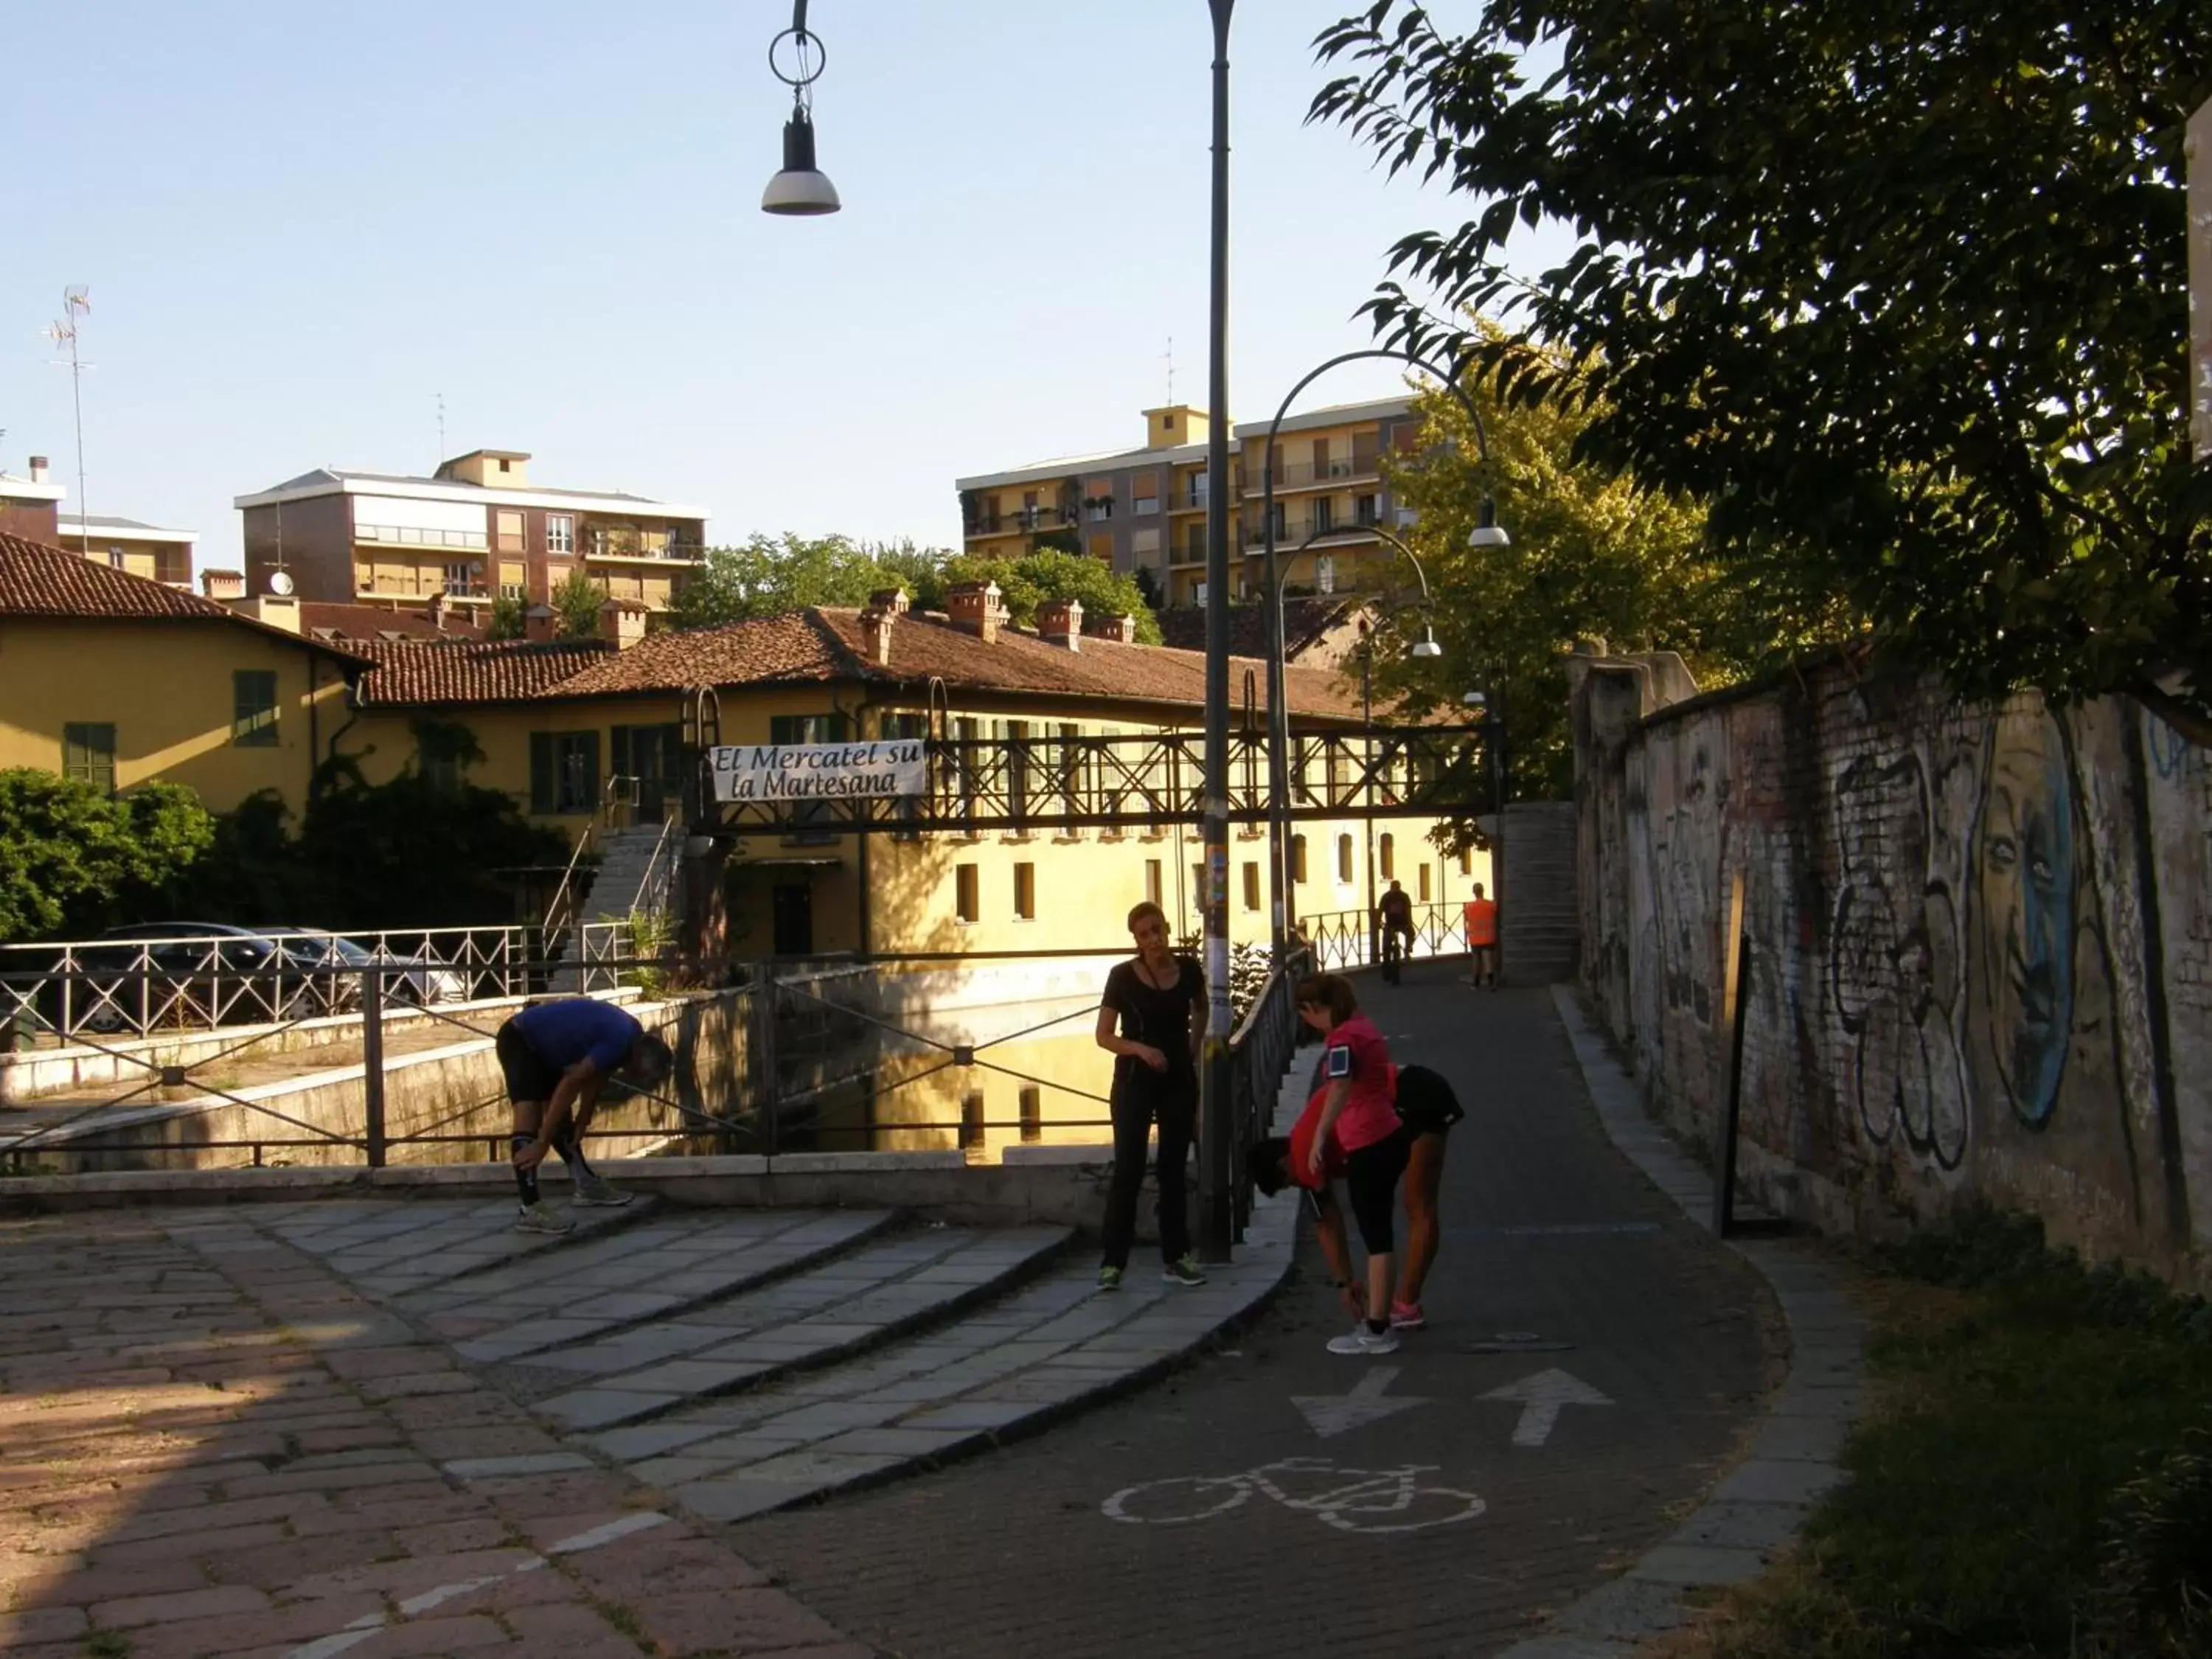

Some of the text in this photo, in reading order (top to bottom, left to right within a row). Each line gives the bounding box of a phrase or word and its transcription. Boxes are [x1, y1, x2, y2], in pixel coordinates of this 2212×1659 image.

[715, 742, 920, 772] El Mercatel su
[731, 771, 898, 799] la Martesana
